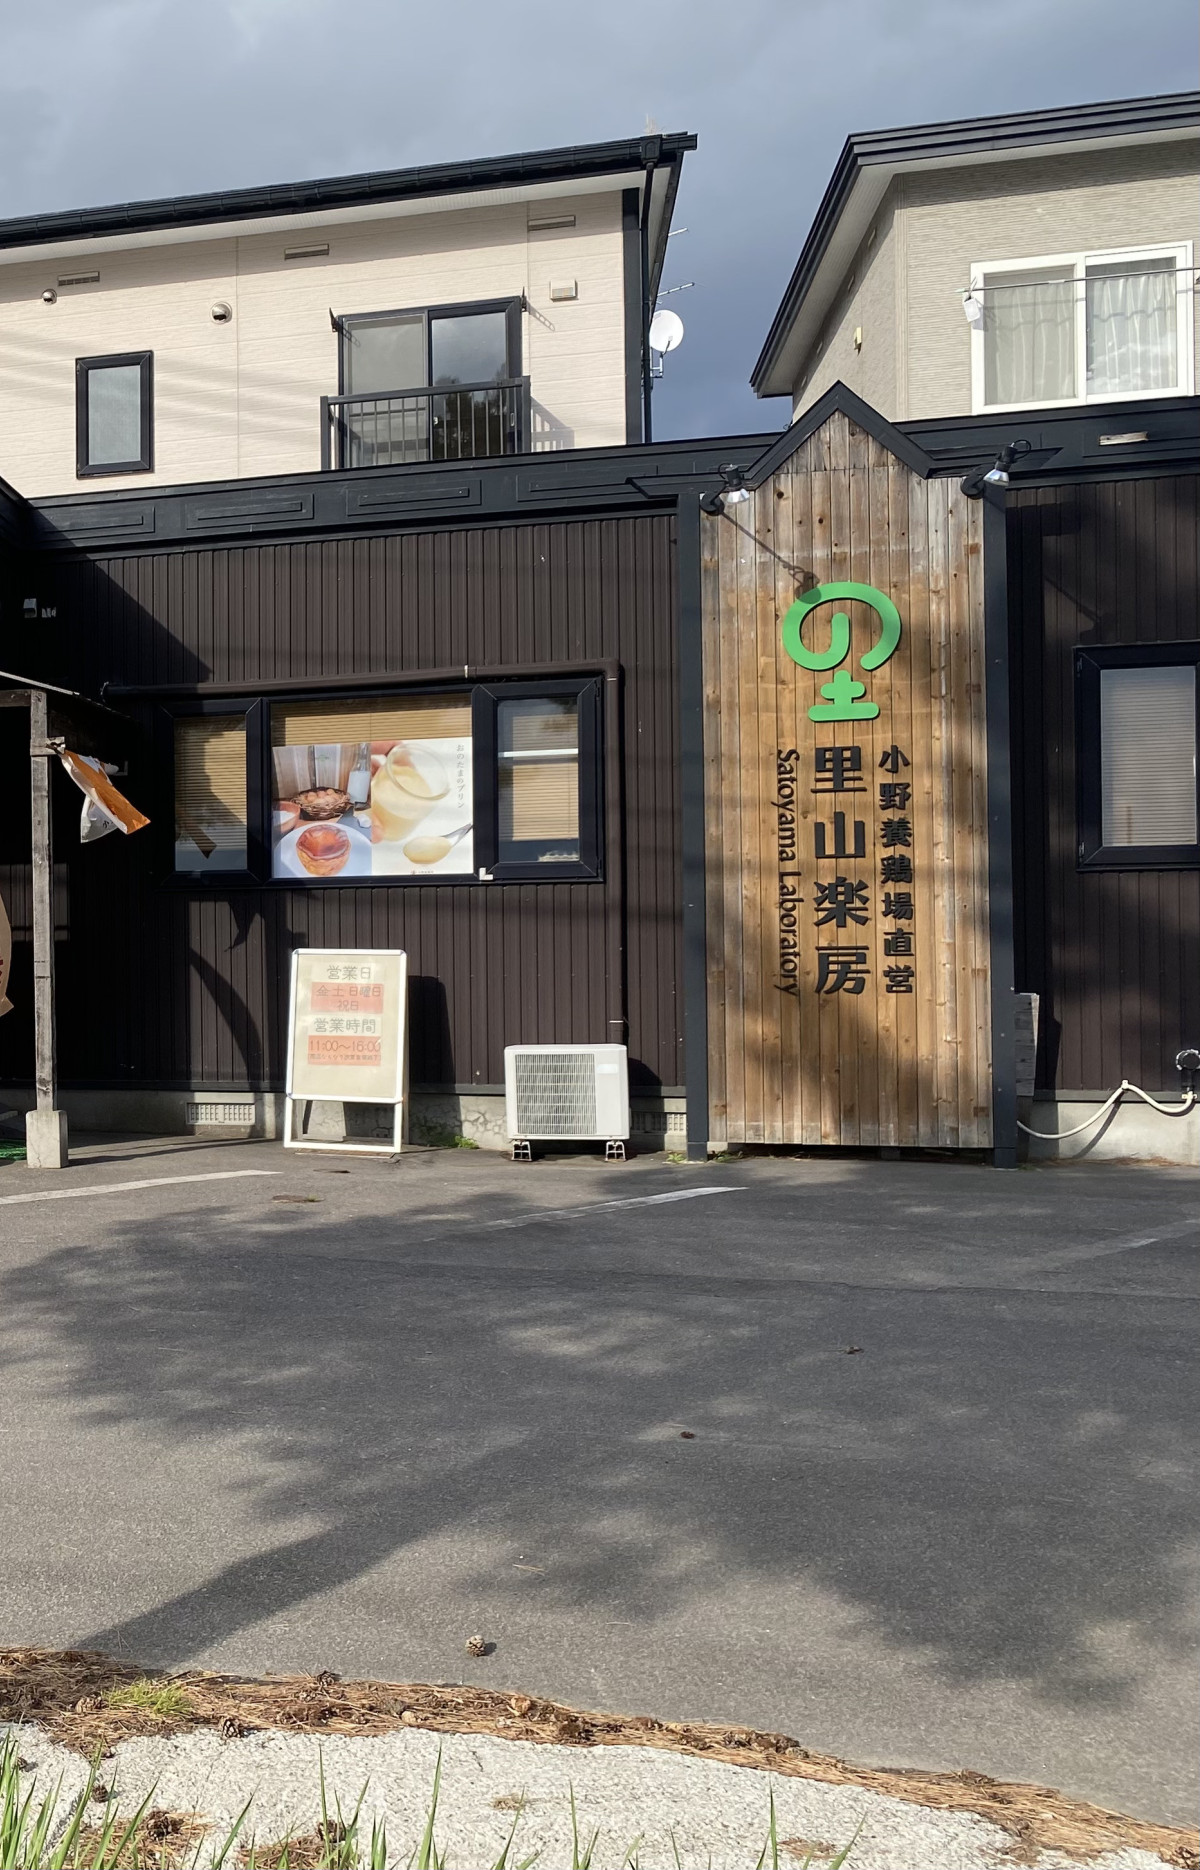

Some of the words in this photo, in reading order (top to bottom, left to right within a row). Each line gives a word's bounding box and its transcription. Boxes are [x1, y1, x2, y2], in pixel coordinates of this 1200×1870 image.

[771, 748, 800, 863] Satoyama
[810, 745, 871, 995] 里山楽房
[878, 744, 914, 994] 小野養鶏場直営
[326, 964, 371, 981] 営業日
[774, 872, 804, 997] Laboratory
[313, 1017, 376, 1034] 営業時間
[337, 1000, 359, 1012] 祝日
